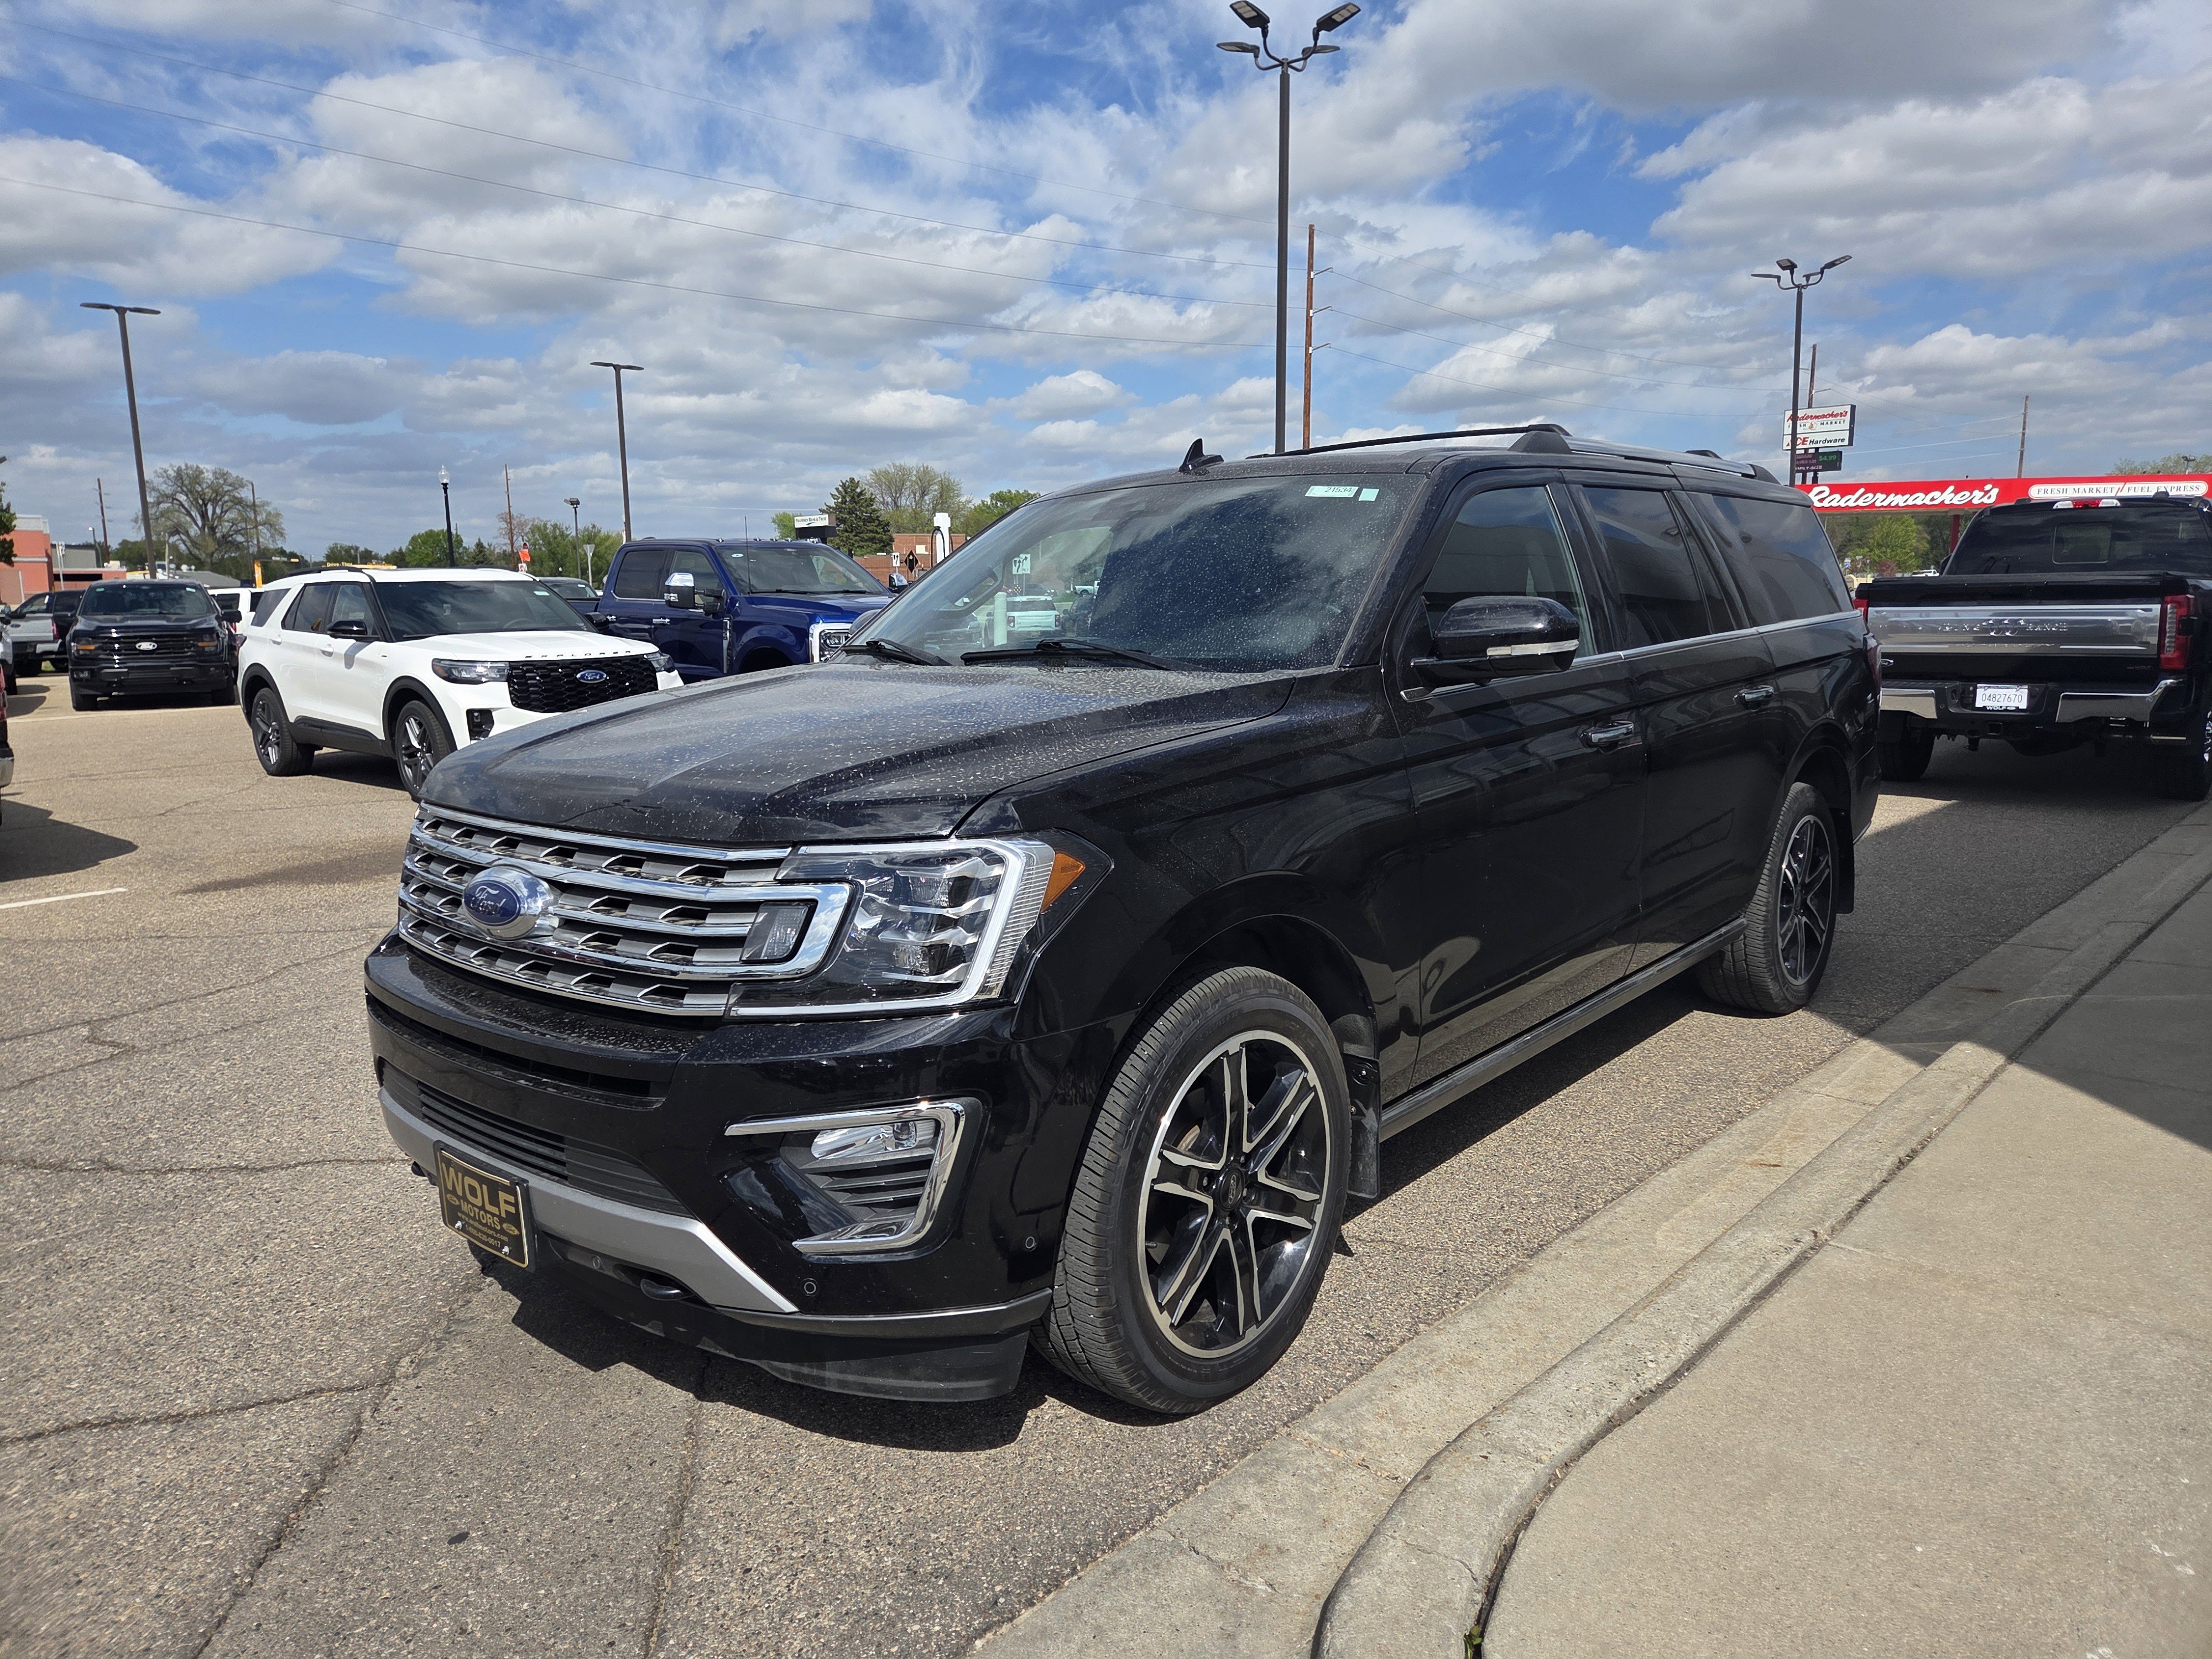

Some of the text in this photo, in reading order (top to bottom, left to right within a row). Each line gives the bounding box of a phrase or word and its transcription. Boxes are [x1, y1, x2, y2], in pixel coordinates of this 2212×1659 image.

[1808, 484, 1999, 508] Radermacher's
[1981, 693, 2022, 703] 04827670
[470, 885, 507, 916] Ford
[441, 1162, 515, 1218] WOLF
[461, 1199, 501, 1230] MOTORS
